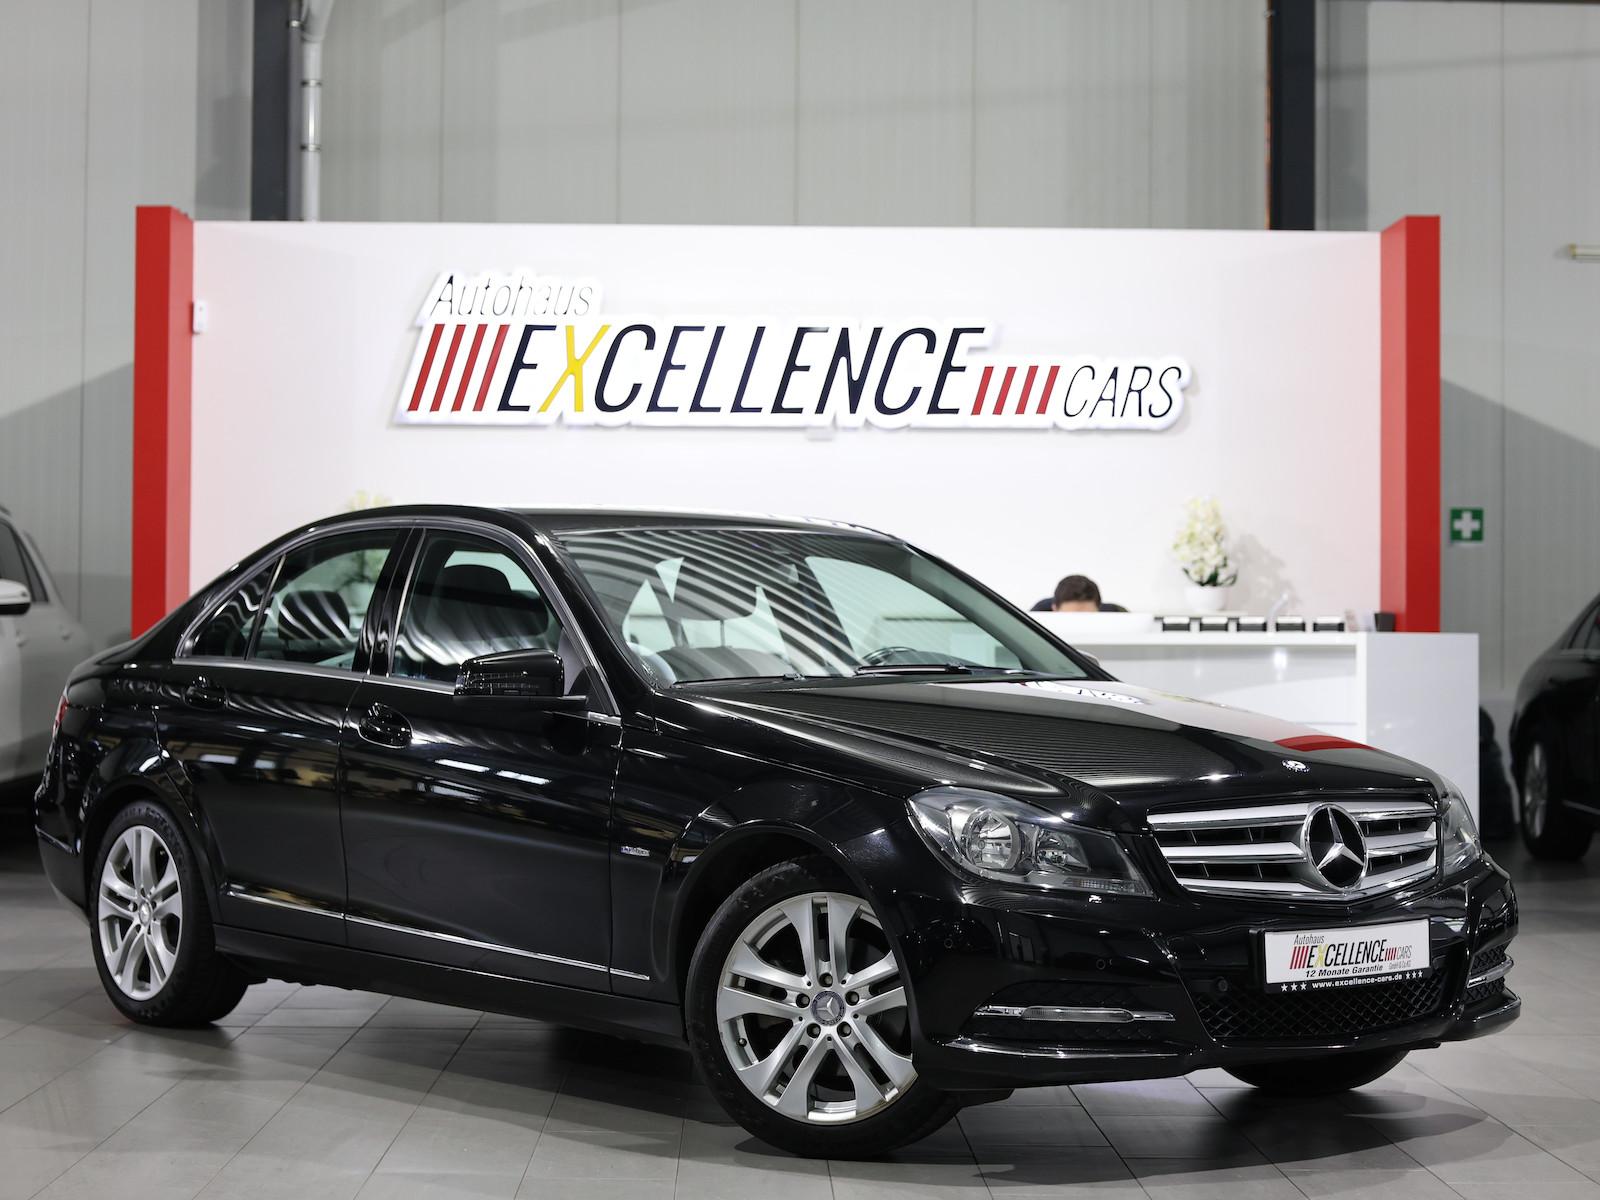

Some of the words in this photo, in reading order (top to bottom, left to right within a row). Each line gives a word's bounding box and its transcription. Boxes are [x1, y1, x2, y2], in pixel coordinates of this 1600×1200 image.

[431, 274, 593, 317] Autohaus
[497, 324, 985, 415] EXCELLENCE
[1064, 365, 1182, 418] CARS
[1293, 934, 1325, 945] Autohaus
[1306, 939, 1387, 968] EXCELLENCE
[1396, 945, 1412, 961] CARS
[1305, 970, 1314, 978] 12
[1318, 967, 1350, 977] Monate
[1352, 964, 1384, 974] Garantie
[1312, 974, 1403, 988] www.excellence-cars.de
